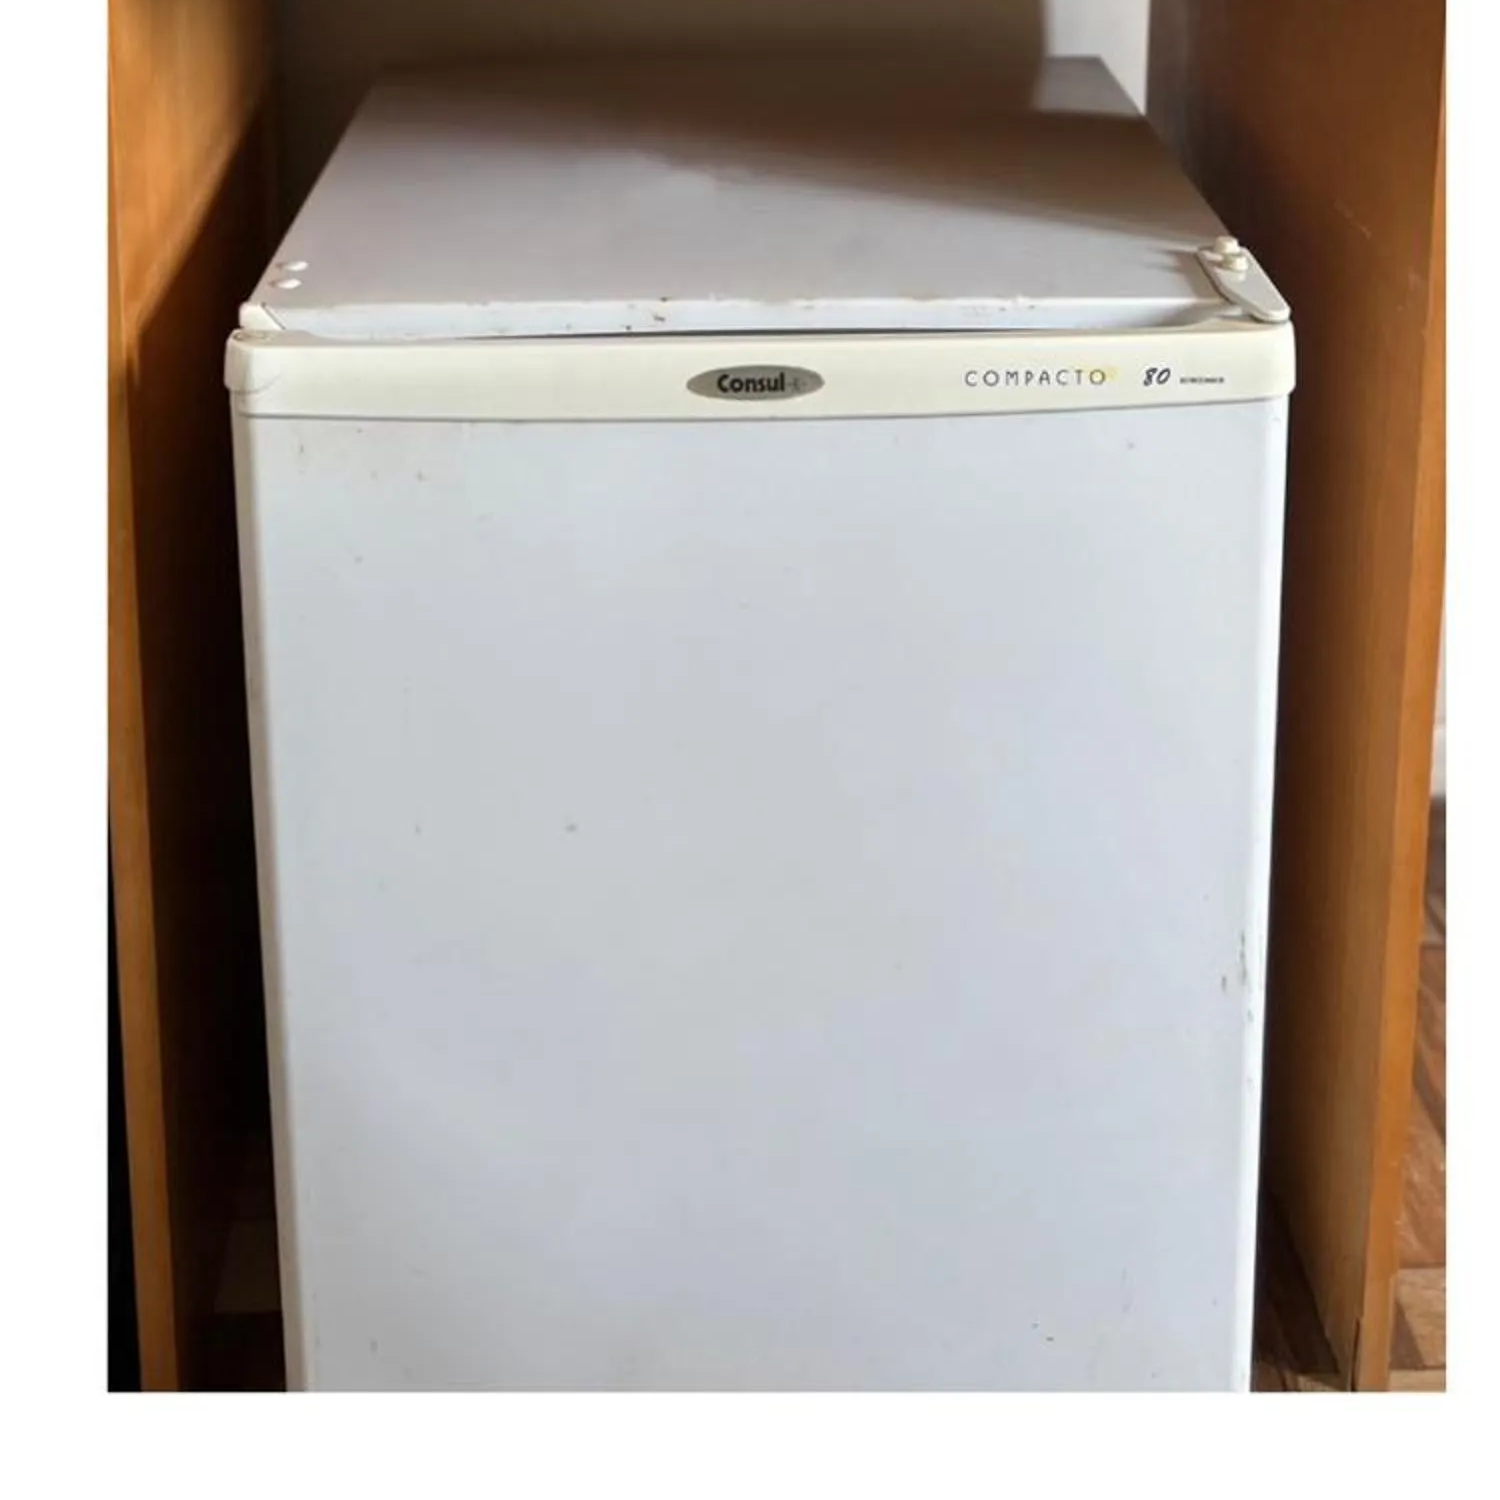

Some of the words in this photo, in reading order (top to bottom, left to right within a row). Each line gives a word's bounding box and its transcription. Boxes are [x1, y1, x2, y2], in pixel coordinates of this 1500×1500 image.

[717, 372, 785, 393] Consul
[964, 369, 1106, 388] COMPACTO
[1143, 367, 1171, 387] 80
